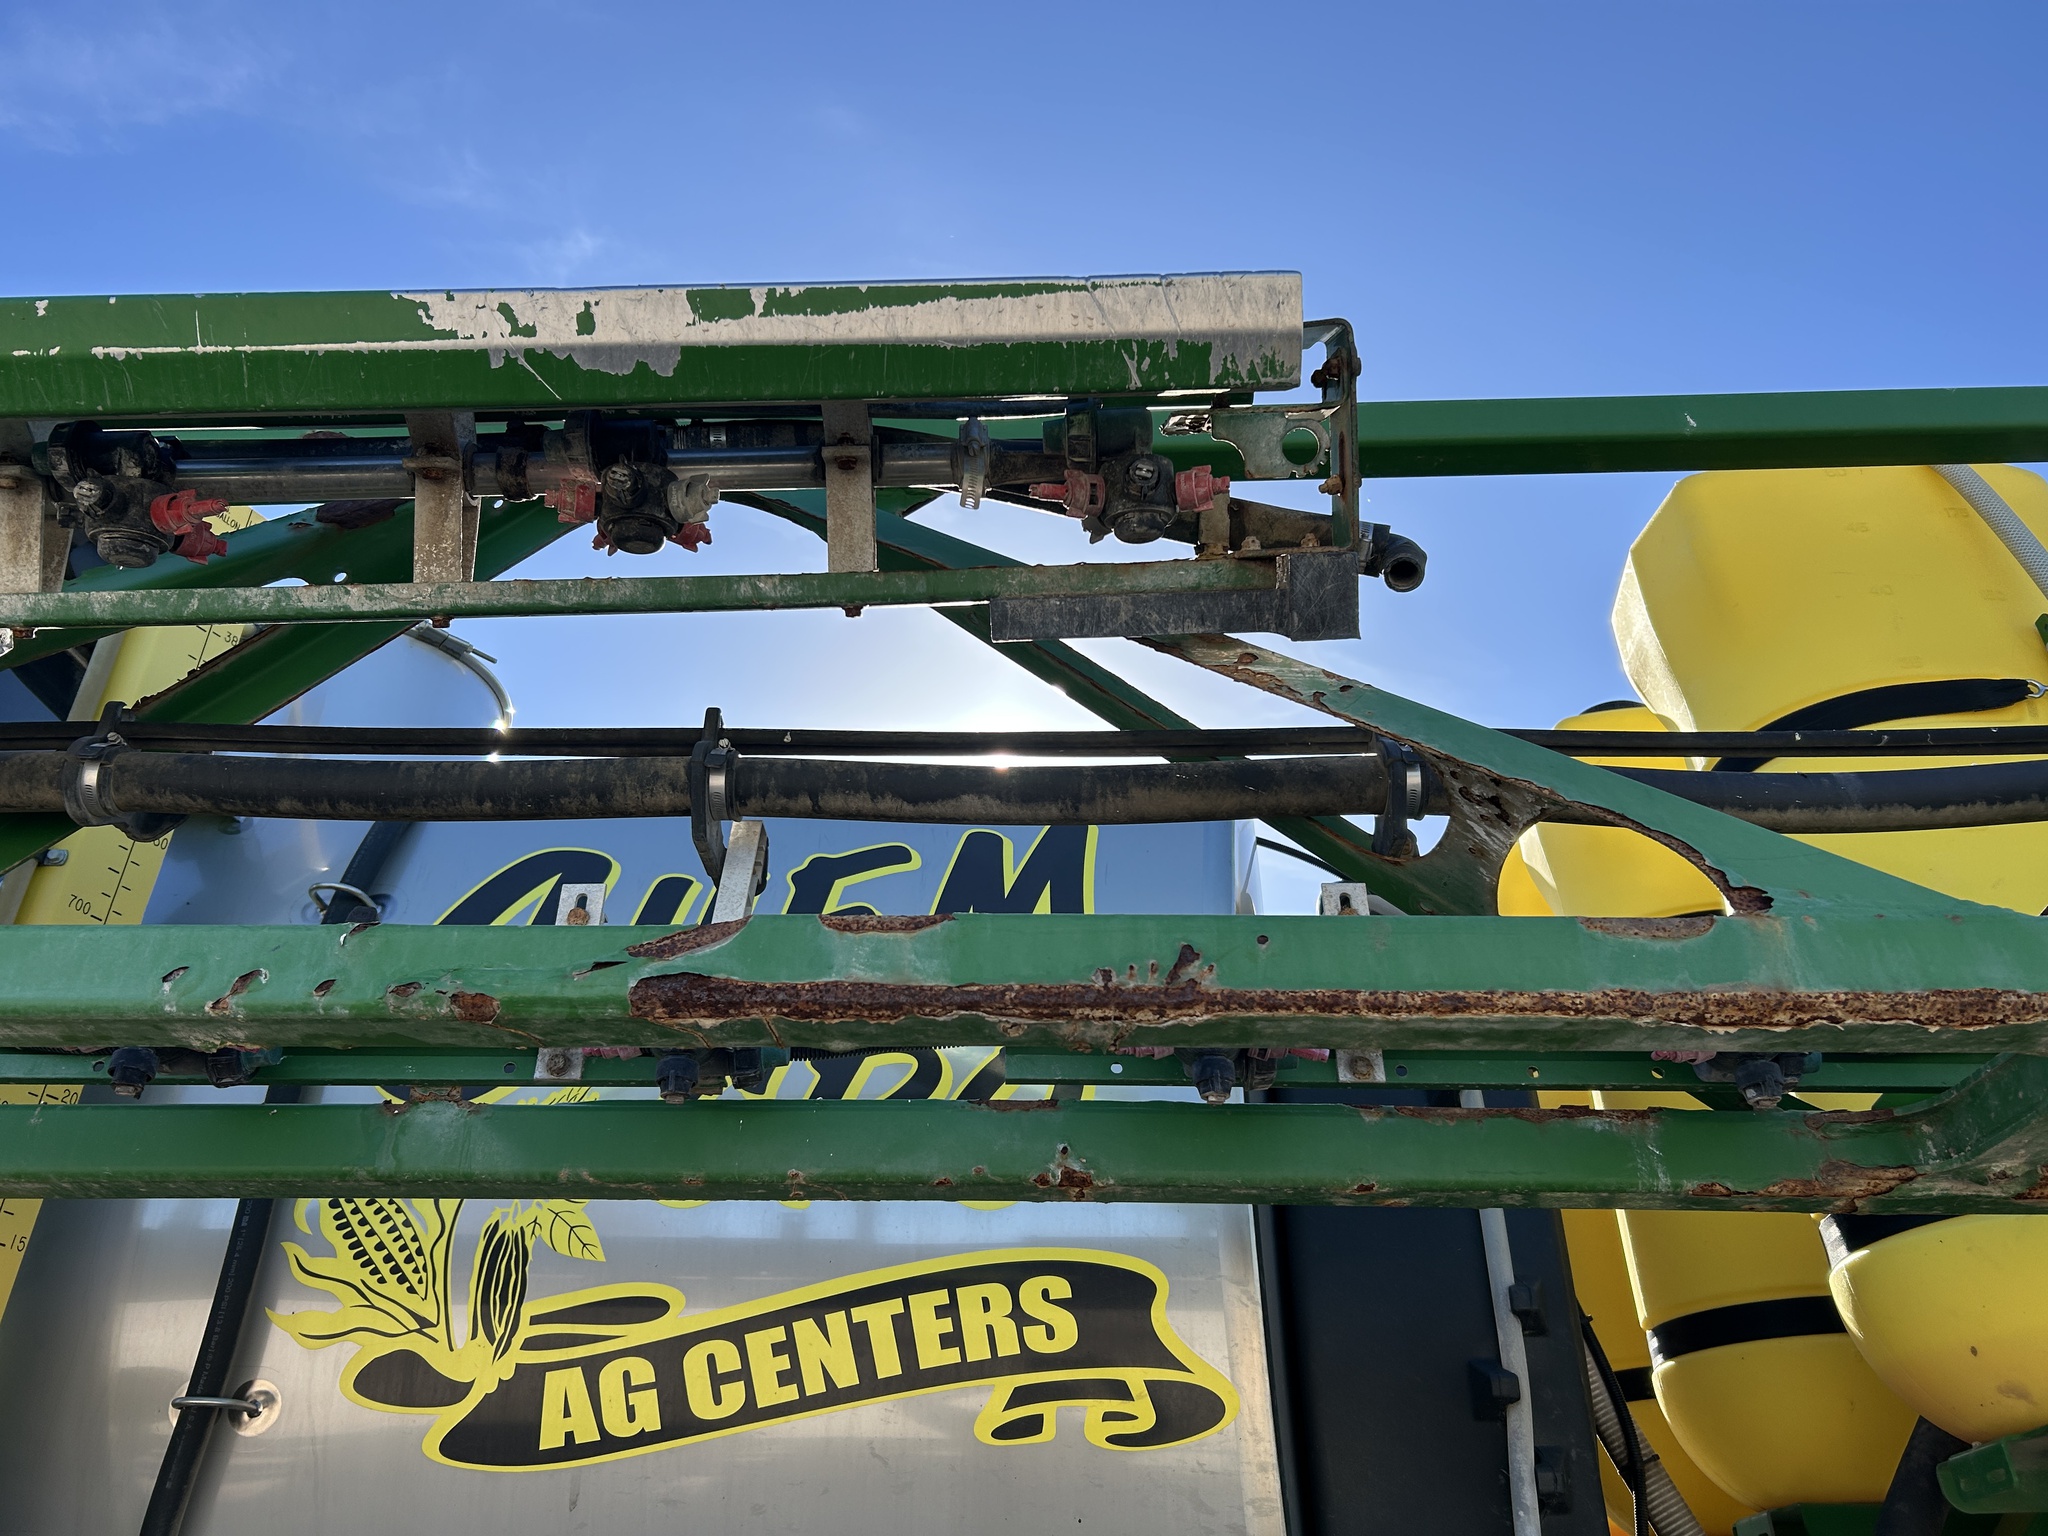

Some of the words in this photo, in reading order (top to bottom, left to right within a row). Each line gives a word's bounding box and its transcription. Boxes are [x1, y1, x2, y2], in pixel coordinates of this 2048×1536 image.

[68, 894, 91, 915] 700
[10, 1234, 27, 1252] 15
[539, 1357, 662, 1451] AG
[683, 1275, 1079, 1421] CENTERS
